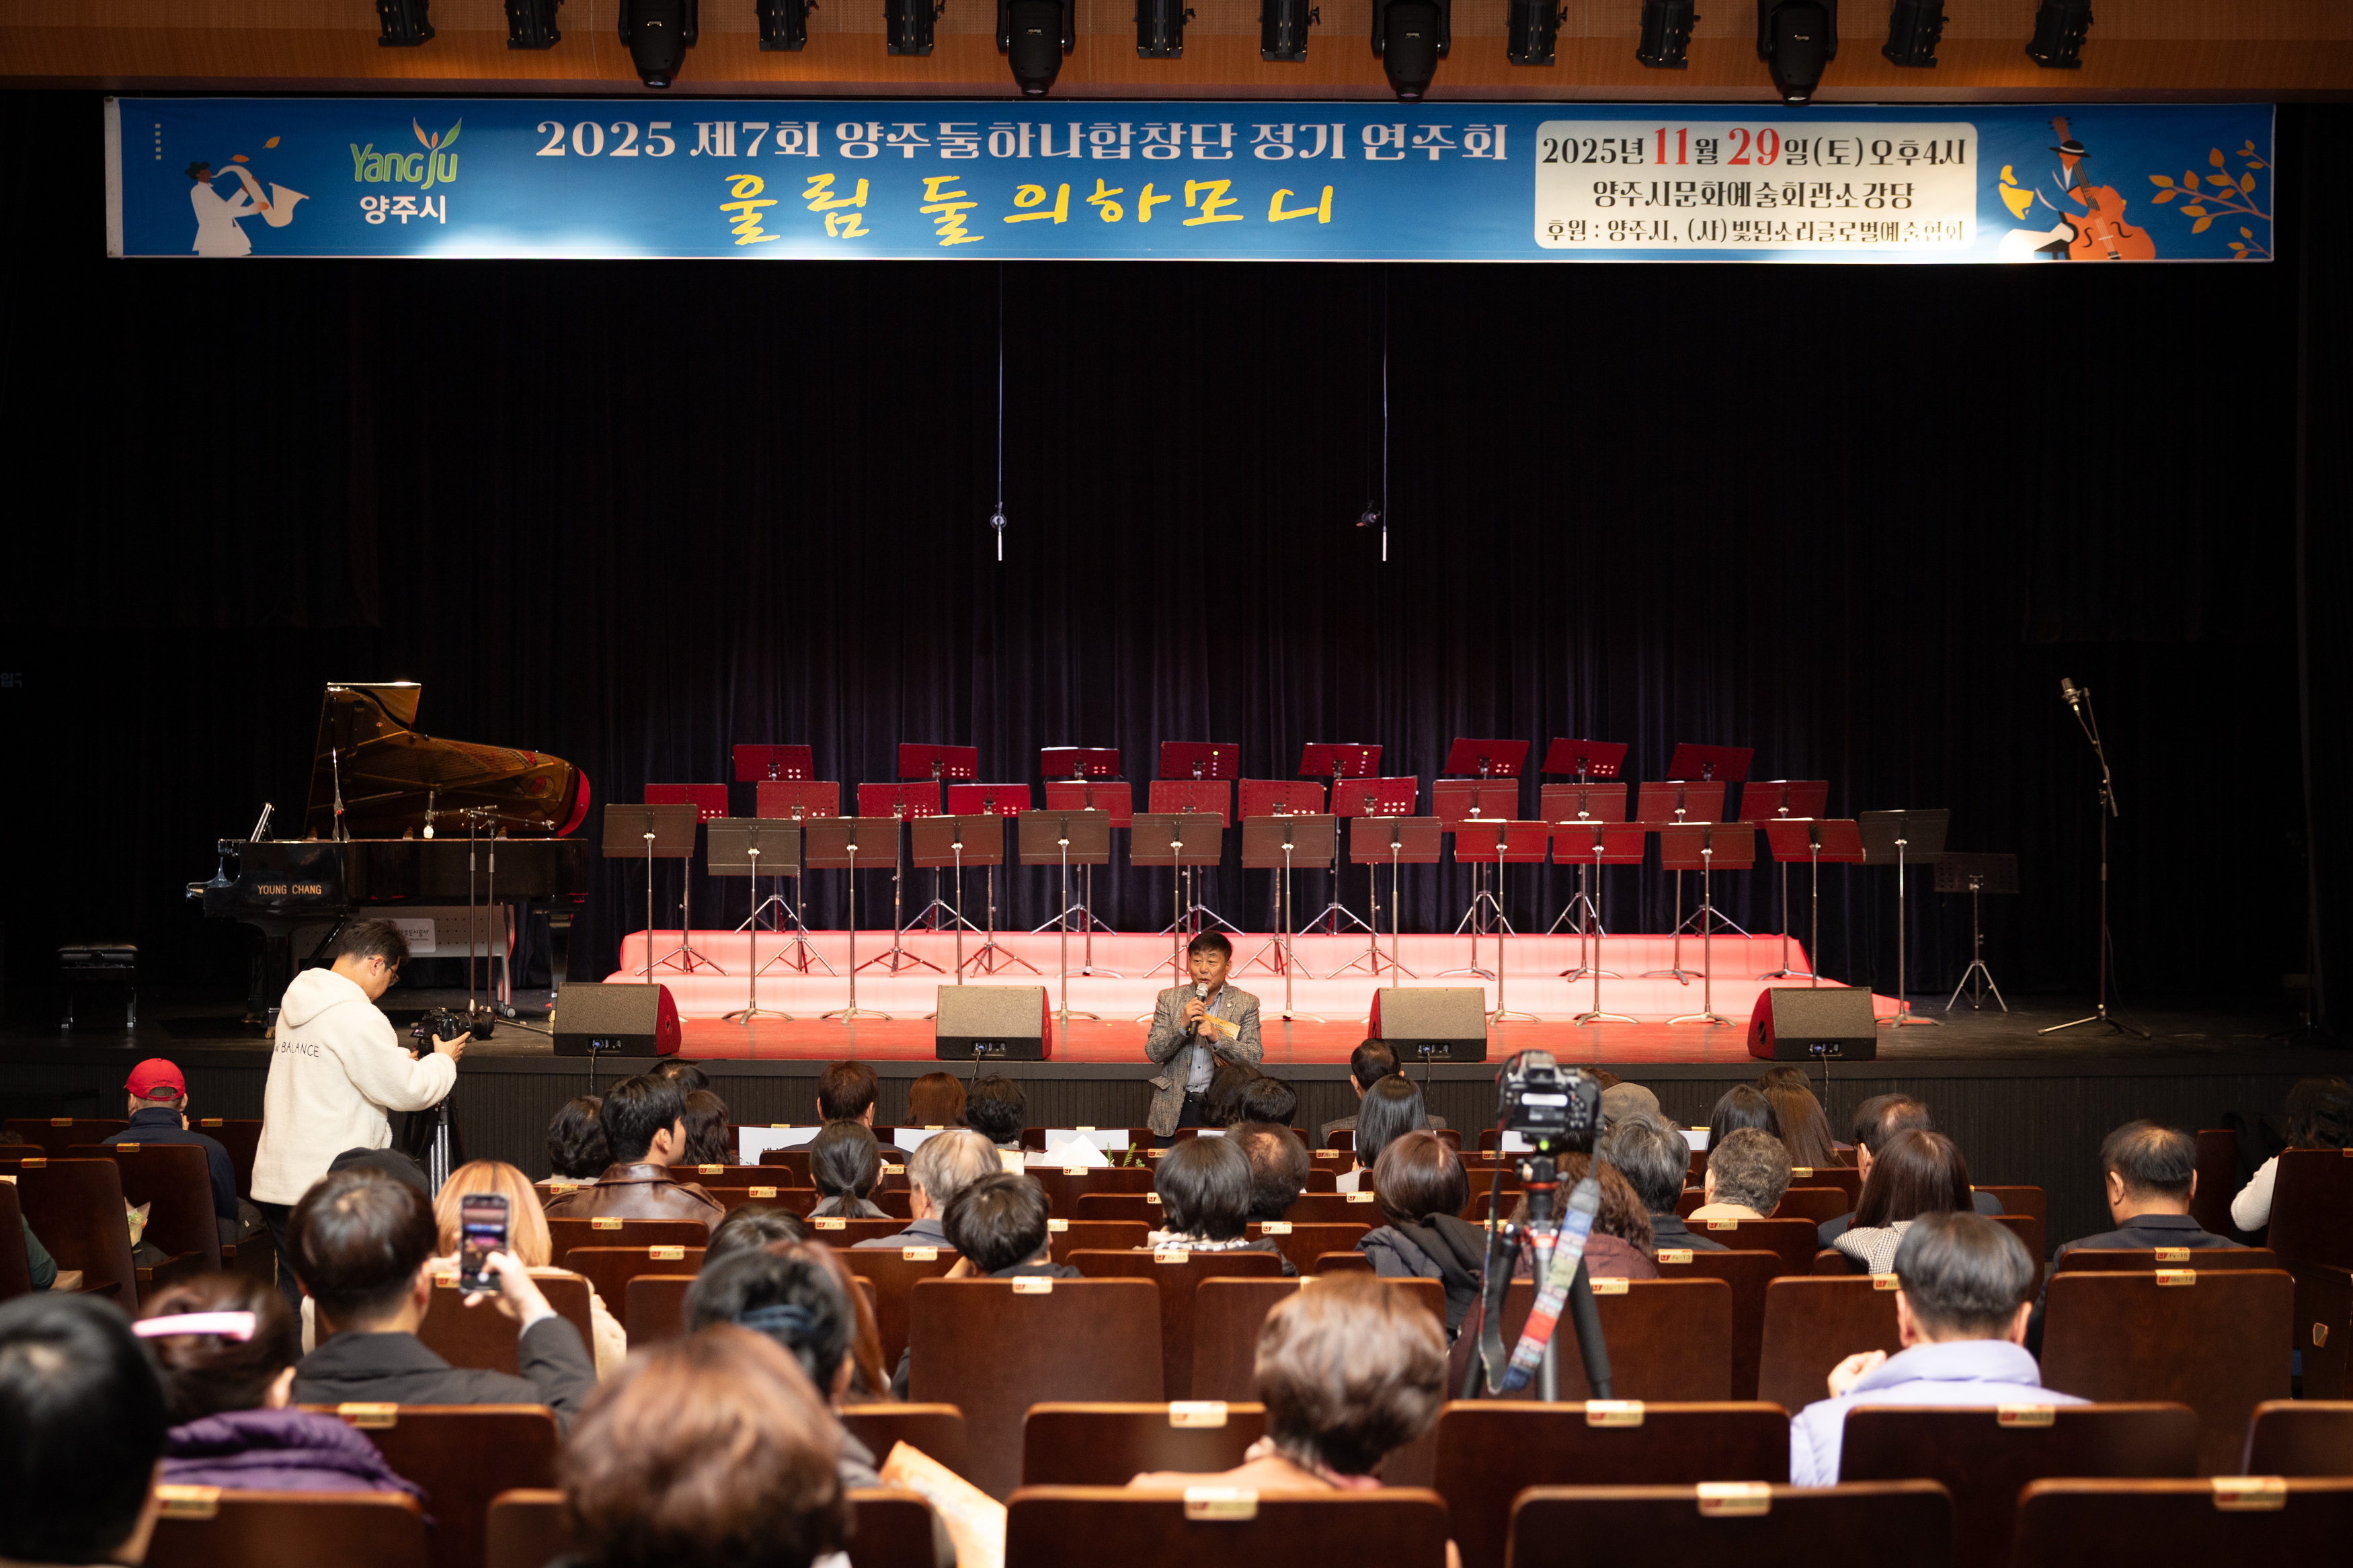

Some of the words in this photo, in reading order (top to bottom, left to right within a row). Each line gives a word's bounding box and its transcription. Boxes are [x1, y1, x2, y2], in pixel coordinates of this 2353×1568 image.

[536, 122, 676, 157] 2025
[690, 122, 820, 157] 제7회
[836, 122, 1238, 159] 양주둘하나합창단
[1250, 124, 1345, 160] 정기
[1362, 124, 1507, 161] 연주회
[1542, 138, 1644, 165] 2025년
[360, 194, 446, 224] 양주시
[1546, 219, 1587, 241] 후원
[257, 884, 287, 895] YOUNG
[292, 884, 321, 895] CHANG
[281, 1041, 319, 1058] BALANCE
